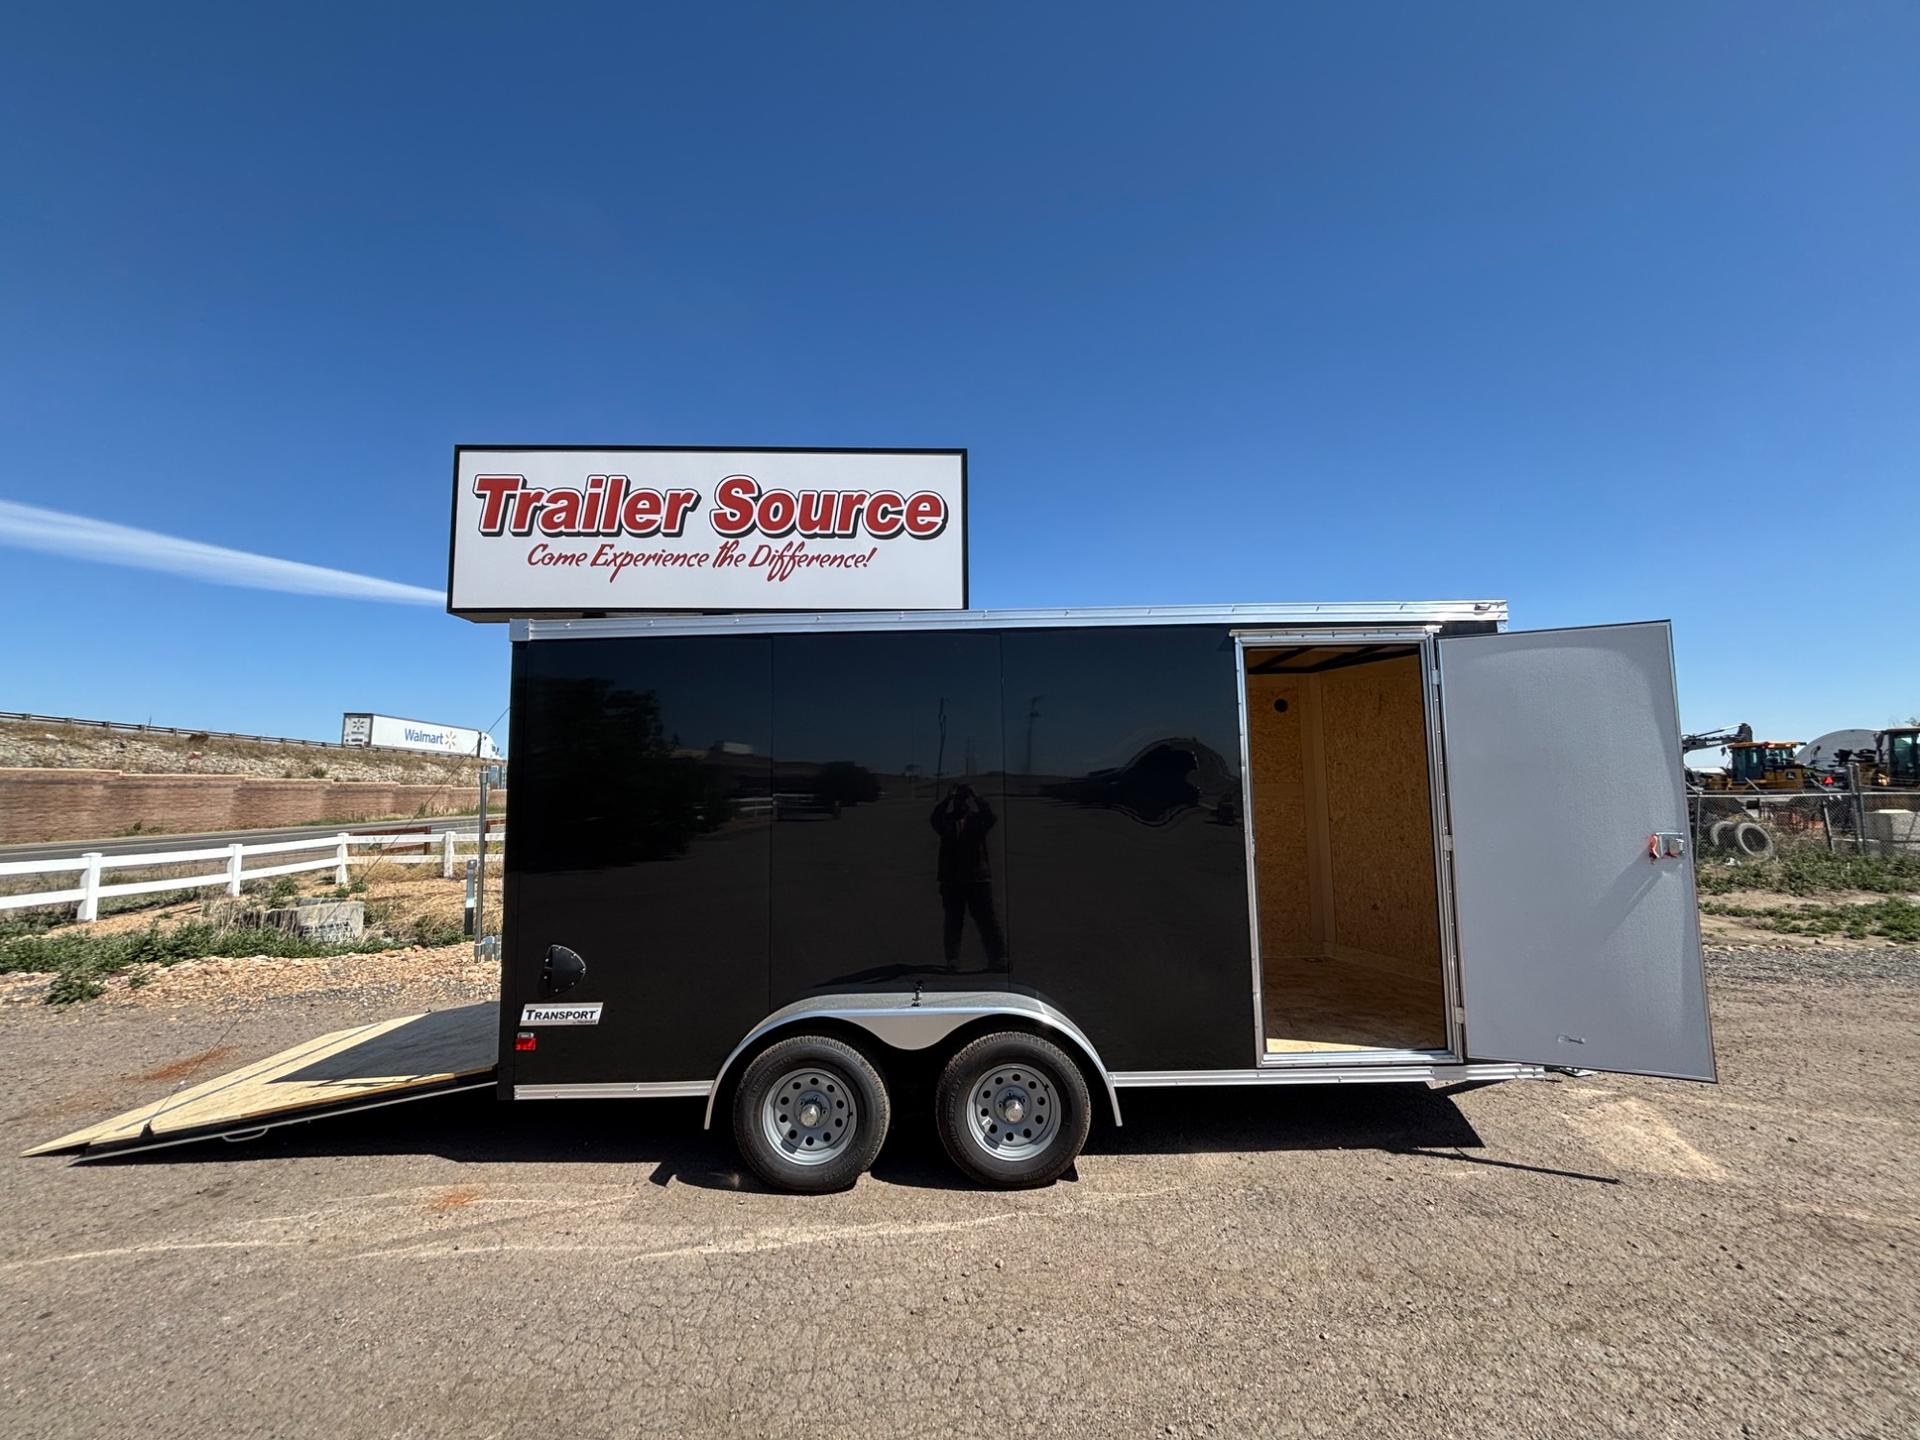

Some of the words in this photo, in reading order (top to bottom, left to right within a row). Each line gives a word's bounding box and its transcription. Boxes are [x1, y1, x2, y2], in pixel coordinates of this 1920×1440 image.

[473, 474, 702, 538] Trailer
[710, 474, 949, 540] Source
[528, 543, 587, 567] Come
[590, 543, 709, 583] Experience
[748, 541, 877, 582] Difference!
[404, 728, 444, 745] Walmart
